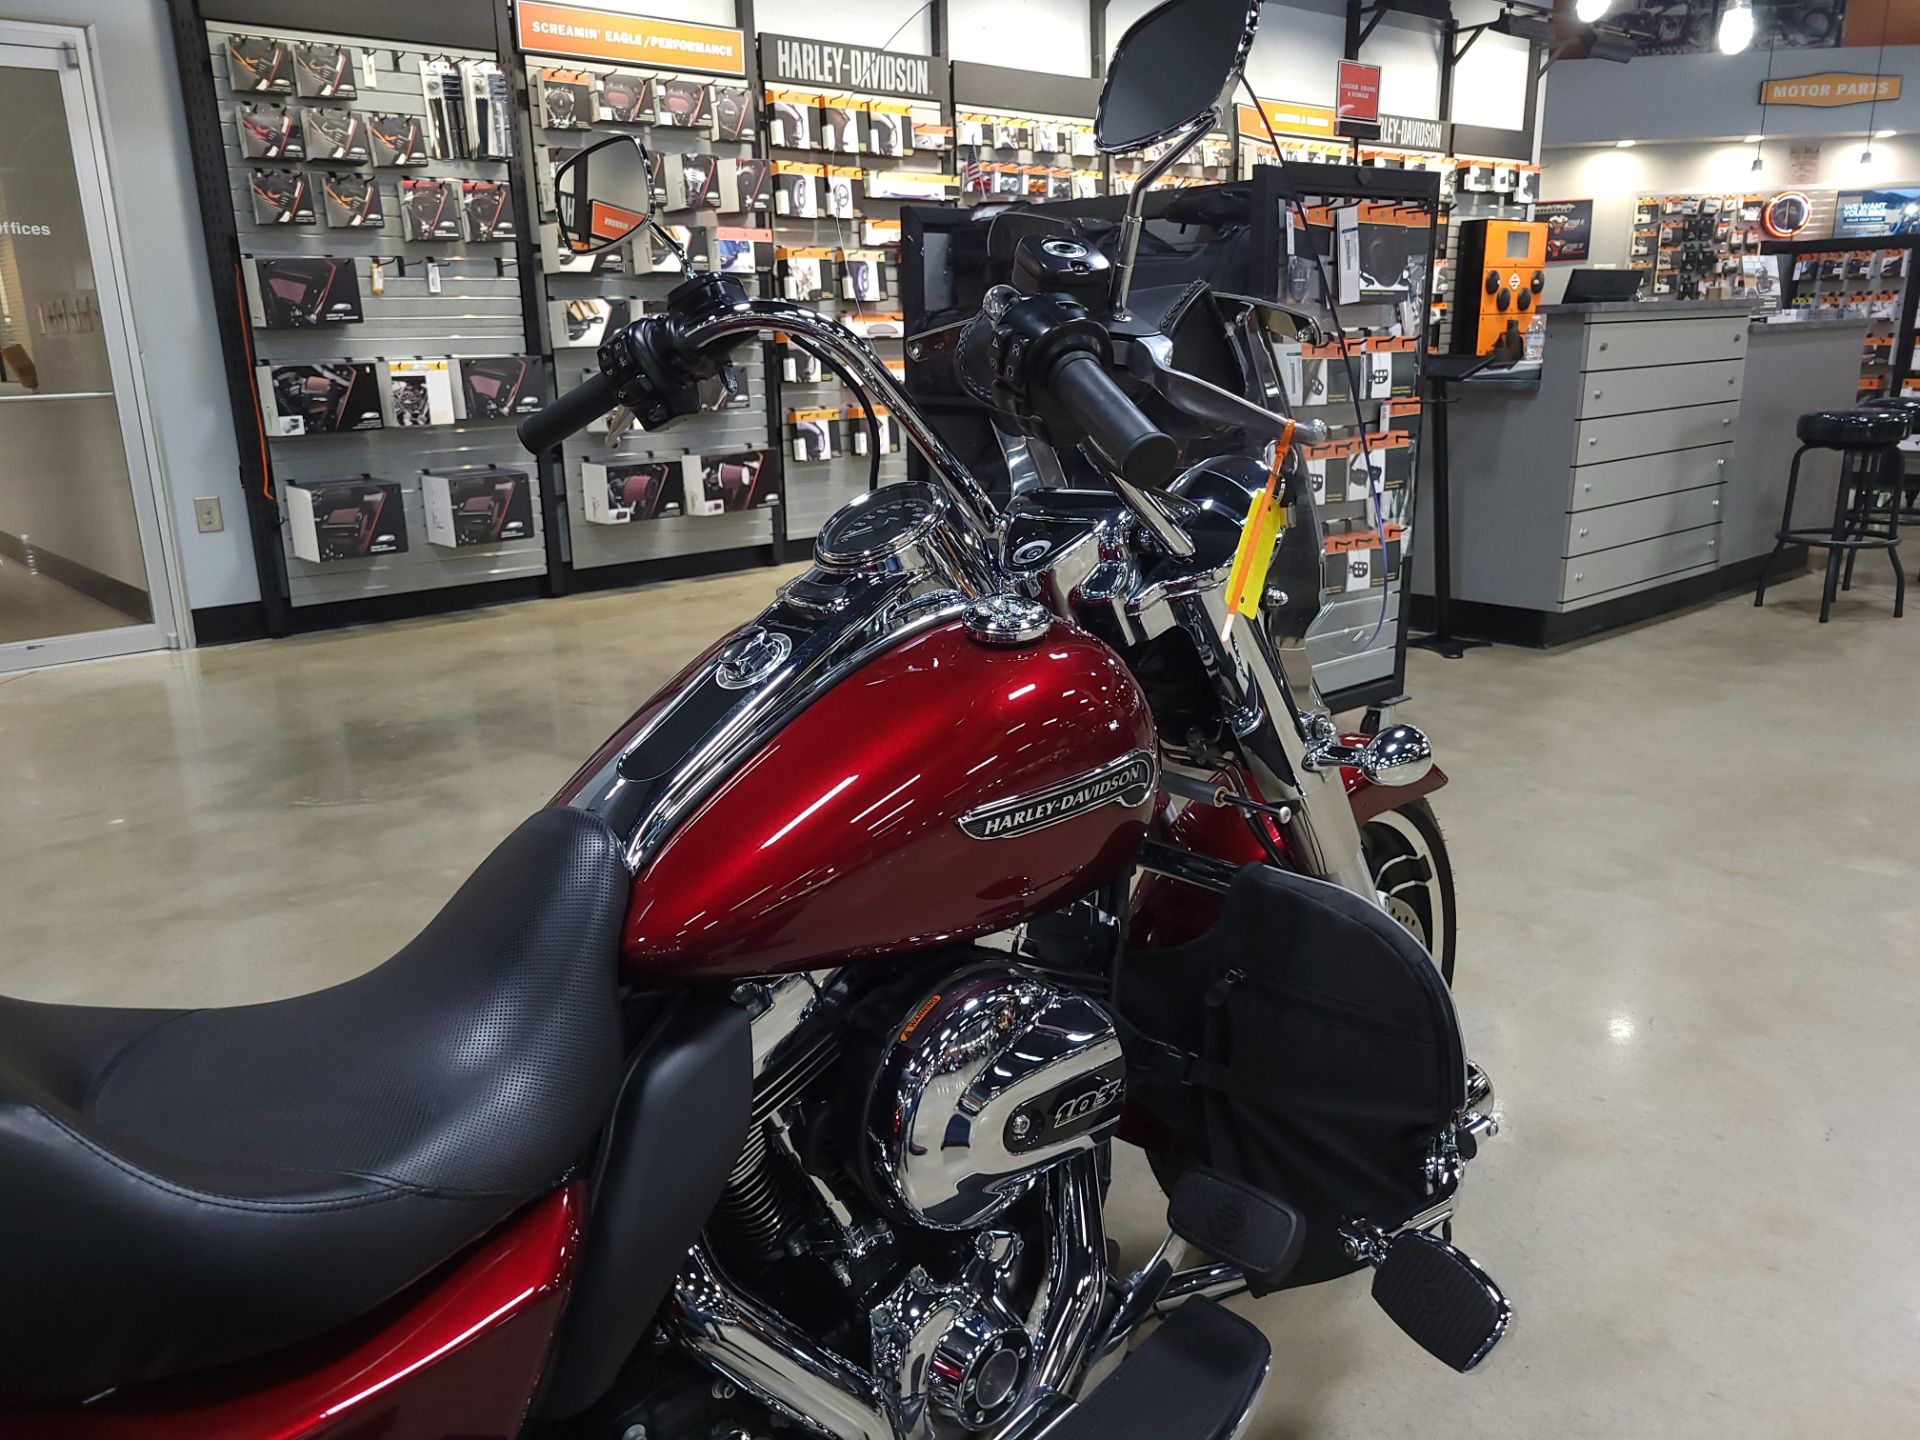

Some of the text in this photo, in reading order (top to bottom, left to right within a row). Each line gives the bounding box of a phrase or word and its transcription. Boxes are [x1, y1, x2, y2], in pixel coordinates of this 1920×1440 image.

[532, 21, 600, 40] SCREAMIN'
[776, 40, 929, 95] HARLEY-DAVIDSON
[1773, 82, 1889, 98] MOTOR PARTS
[1379, 117, 1442, 148] RLEY-DAVIDSON
[1843, 209, 1867, 217] YOUR
[1844, 202, 1888, 211] WE WANT
[0, 221, 51, 235] ffices
[984, 765, 1140, 835] HARLEY-DAVIDSON
[909, 997, 938, 1027] WARNING
[1053, 1079, 1121, 1128] 103
